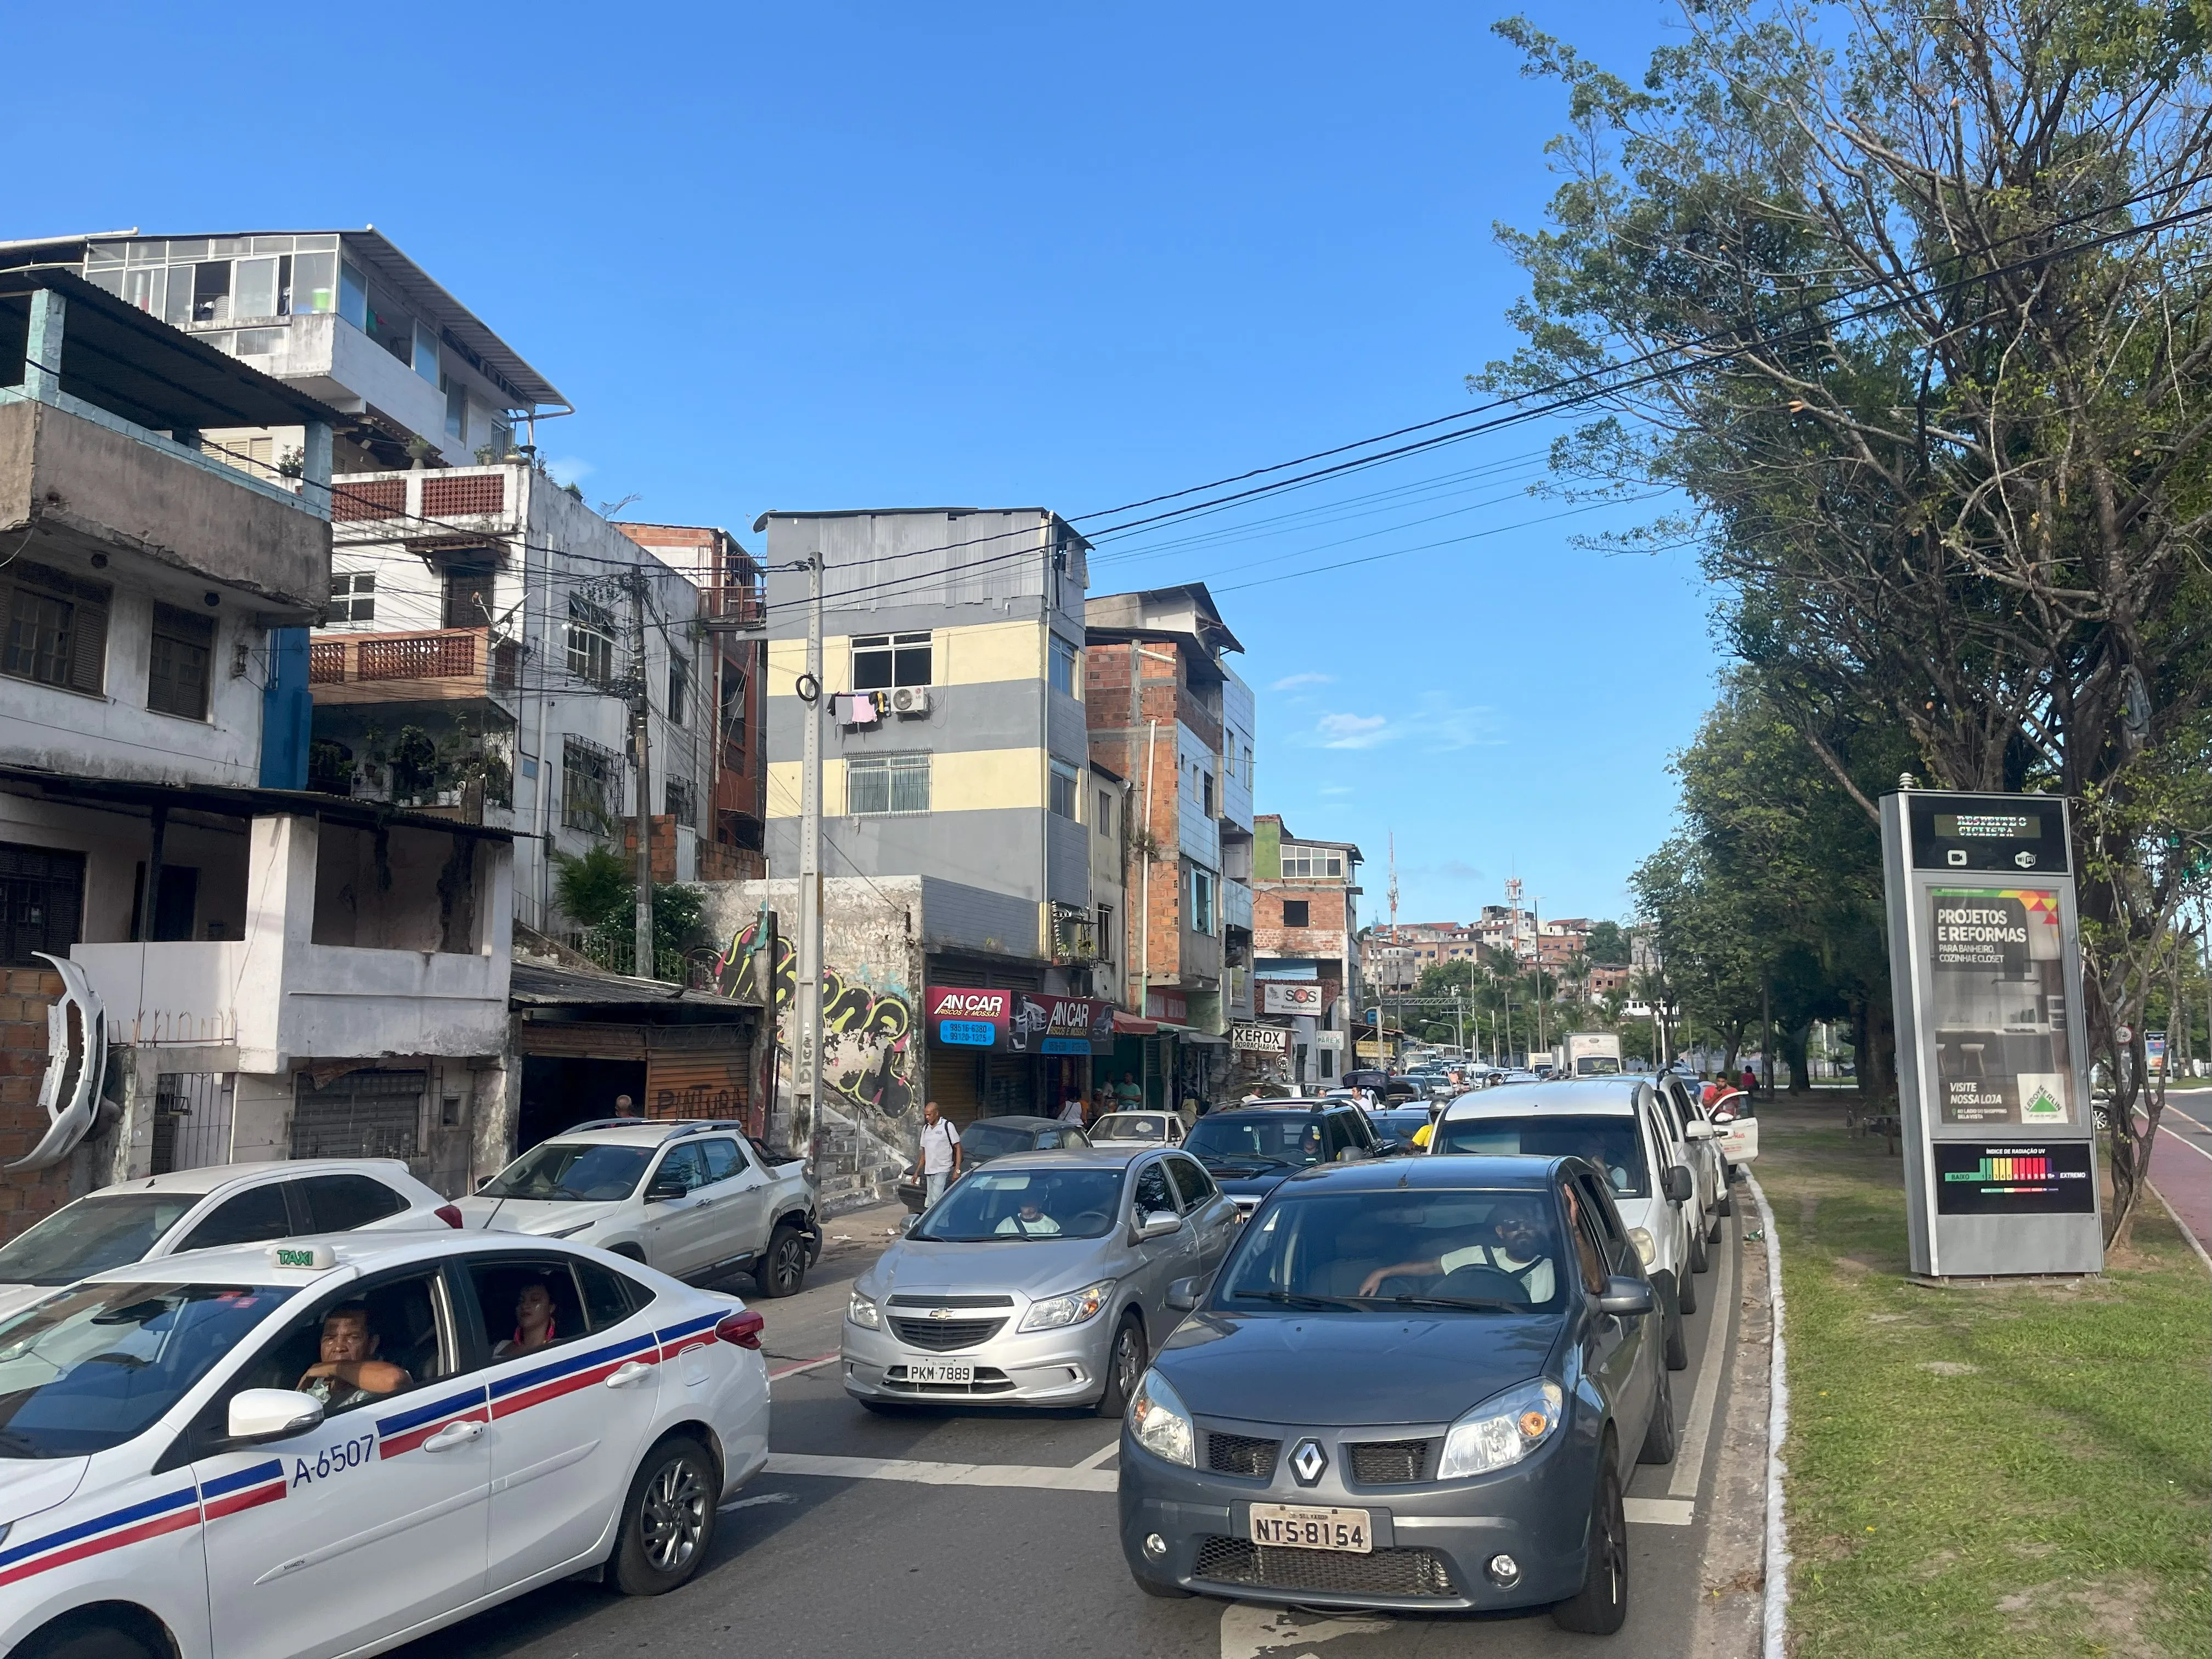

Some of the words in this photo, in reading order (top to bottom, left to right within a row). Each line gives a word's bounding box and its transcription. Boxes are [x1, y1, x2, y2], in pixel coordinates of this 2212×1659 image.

[1938, 909, 2008, 925] PROJETOS
[1938, 926, 1947, 941] E
[1949, 926, 2027, 943] REFORMAS
[1939, 944, 1959, 953] PARA
[1959, 945, 1995, 954] BANHEIRO,
[1939, 954, 1972, 963] COZINHA
[1972, 955, 1977, 963] E
[1977, 955, 2005, 963] CLOSET
[934, 994, 964, 1014] AN
[965, 995, 1003, 1012] CAR
[1067, 1002, 1089, 1028] CAR
[950, 1032, 987, 1042] 99120-1325
[1234, 1029, 1280, 1044] XEROX
[1235, 1041, 1276, 1051] BORRACHARIA
[1950, 1082, 1977, 1092] VISITE
[657, 1084, 742, 1120] PINTURA
[1950, 1094, 1980, 1104] NOSSA
[1980, 1094, 2002, 1104] LOJA
[2023, 1089, 2041, 1111] LEROY
[2039, 1084, 2062, 1111] MERLIN
[277, 1250, 313, 1266] TAXI
[293, 1434, 374, 1488] A-6507
